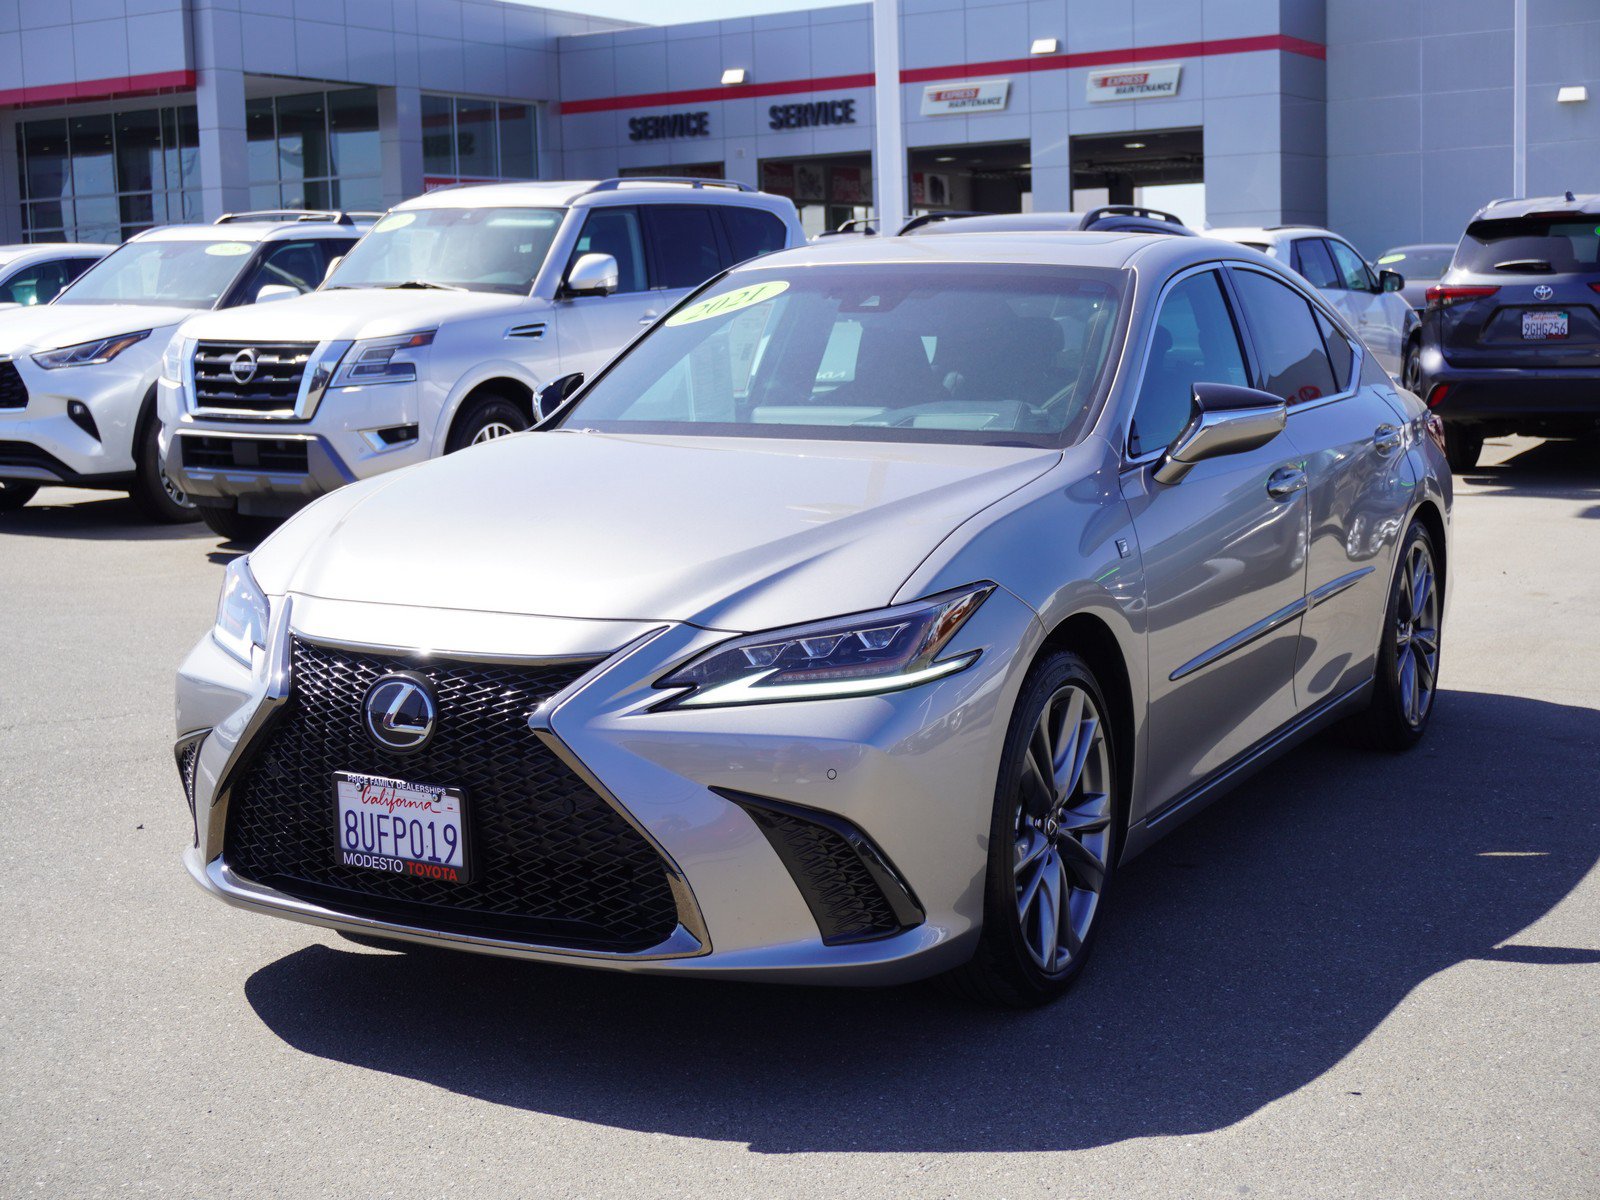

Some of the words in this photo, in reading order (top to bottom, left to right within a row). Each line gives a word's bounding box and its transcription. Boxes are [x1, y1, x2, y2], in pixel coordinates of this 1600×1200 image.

[1105, 74, 1146, 87] EXPRESS
[1115, 82, 1174, 95] MAINTENANCE
[940, 88, 979, 100] EXPRESS
[948, 97, 1002, 109] MAINTENANCE
[768, 99, 857, 131] SERVICE
[628, 111, 710, 142] SERVICE
[683, 286, 769, 322] 2021
[1524, 322, 1566, 336] 9GHG256
[347, 775, 369, 785] PRICE
[370, 777, 395, 788] FAMILY
[396, 781, 447, 796] DEALERSHIPS
[361, 784, 441, 814] California
[344, 809, 458, 864] 8UFP019
[343, 852, 404, 873] MODESTO
[406, 861, 458, 881] TOYOTA
